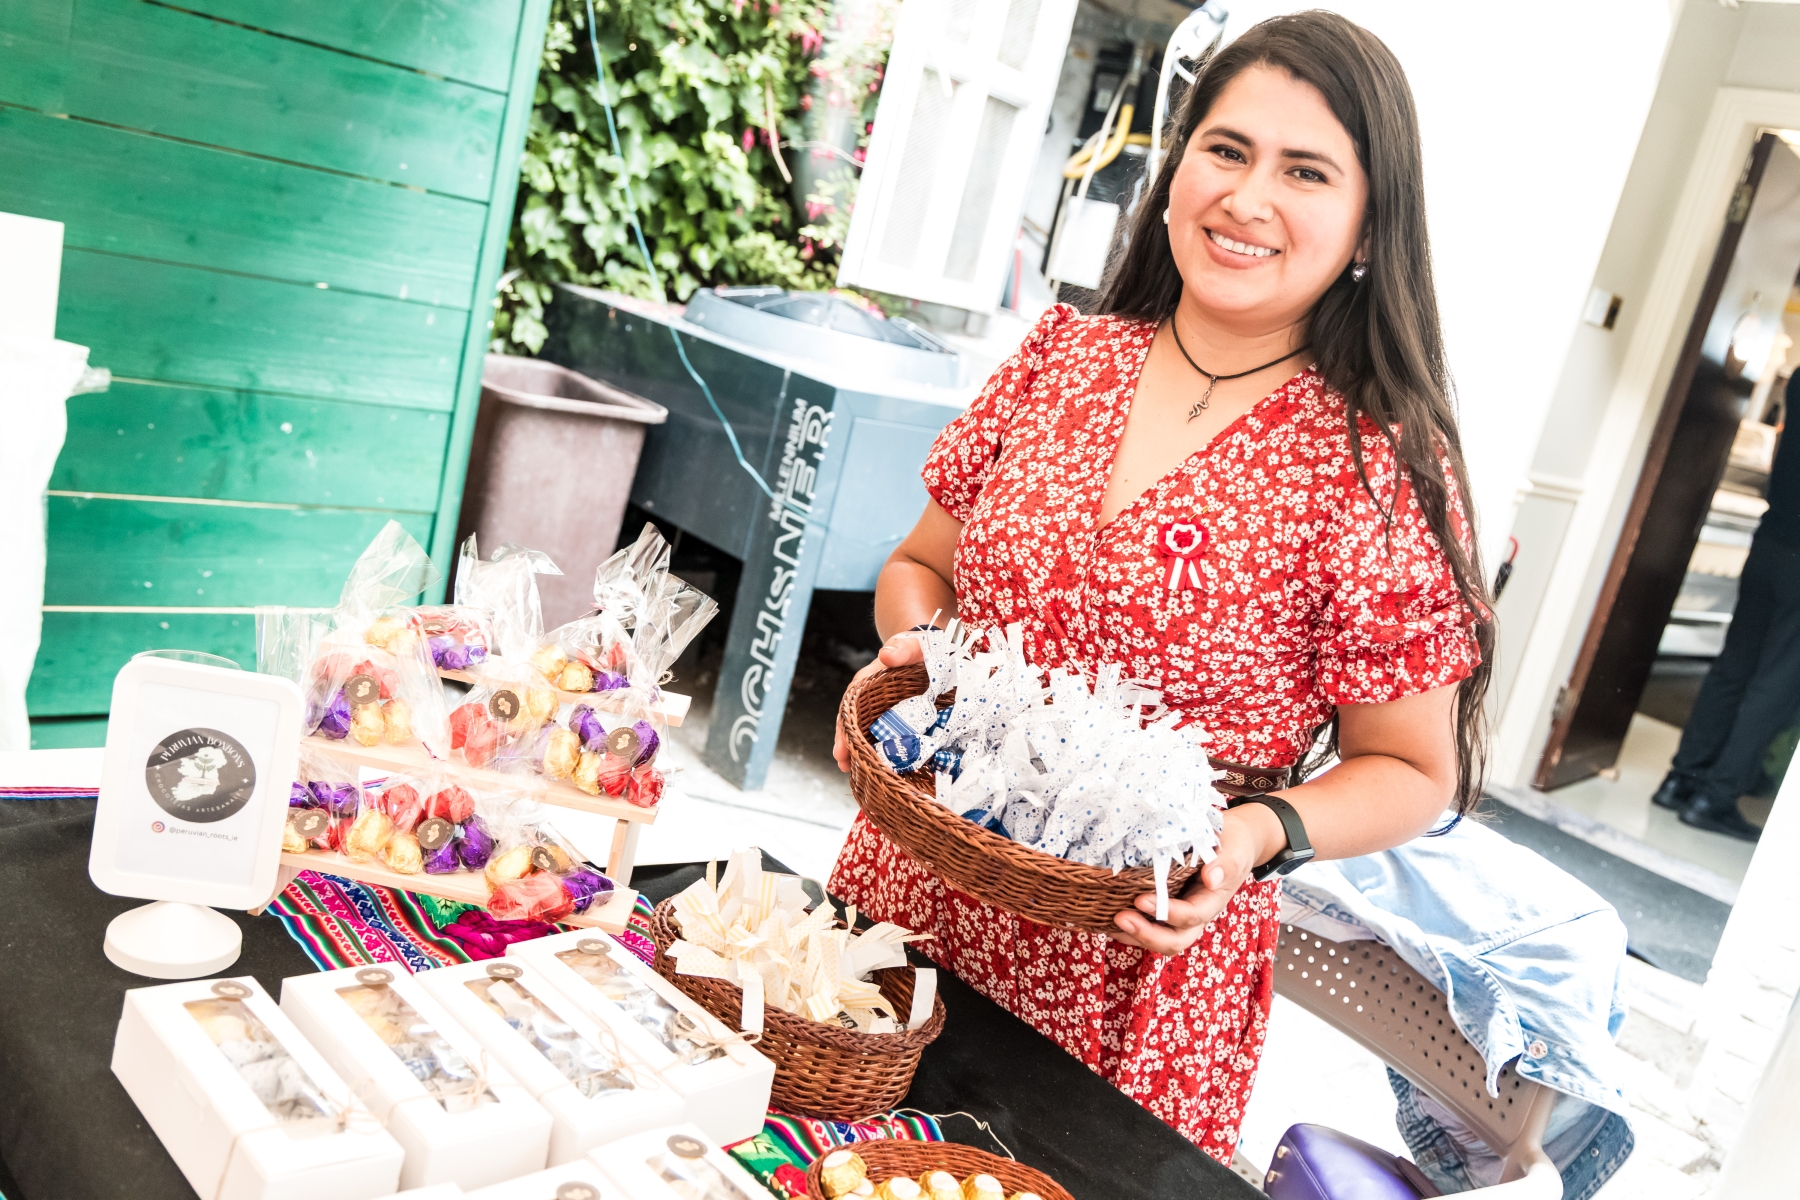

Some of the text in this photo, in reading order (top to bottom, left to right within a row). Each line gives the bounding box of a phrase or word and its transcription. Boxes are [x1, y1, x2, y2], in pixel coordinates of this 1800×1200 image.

[160, 735, 246, 768] PERUVIAN BONBONS
[155, 773, 244, 813] CHOCOTEJAS ARTESANALES
[169, 826, 239, 842] @peruvian_roots_ie
